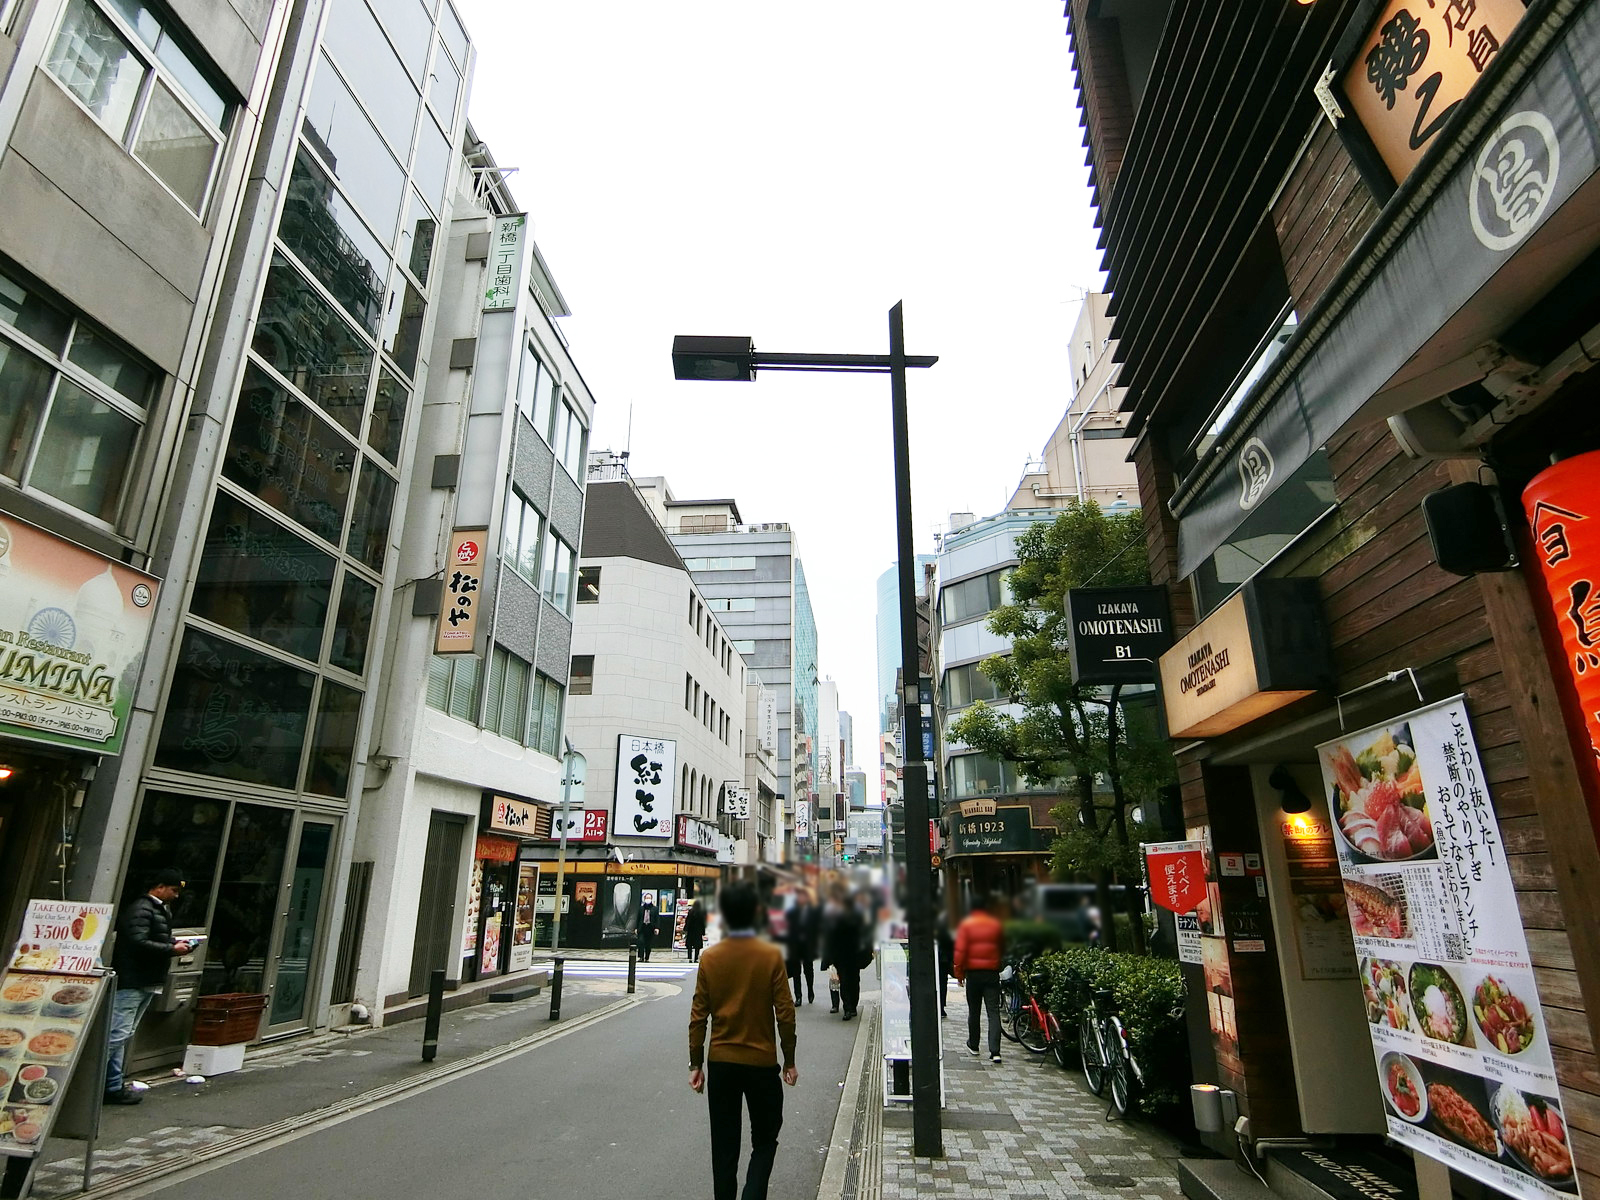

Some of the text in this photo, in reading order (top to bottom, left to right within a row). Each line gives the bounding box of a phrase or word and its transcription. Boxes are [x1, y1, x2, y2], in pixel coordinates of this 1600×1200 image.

[493, 222, 519, 296] 新橋二丁目歯科
[489, 299, 511, 307] 4F
[449, 571, 478, 627] 松のや
[1098, 602, 1139, 614] IZAKAYA
[1079, 618, 1163, 636] OMOTENASHI
[16, 630, 91, 666] Restaurant
[1115, 645, 1132, 658] B1
[1188, 642, 1213, 669] IZAKAYA
[1180, 648, 1231, 695] OMOTENASHI
[62, 706, 98, 720] ルミナ
[631, 739, 665, 754] 日本橋
[586, 812, 606, 828] 2F
[1441, 742, 1482, 882] 禁断のやりすぎ
[979, 821, 1005, 833] 1923
[1437, 785, 1479, 938] おもてなしランチ
[1177, 856, 1190, 895] ペイペイ
[1164, 864, 1180, 908] 使えます。
[33, 903, 108, 915] TAKE OUT MENU
[33, 924, 70, 941] ¥500
[58, 956, 93, 971] ¥700
